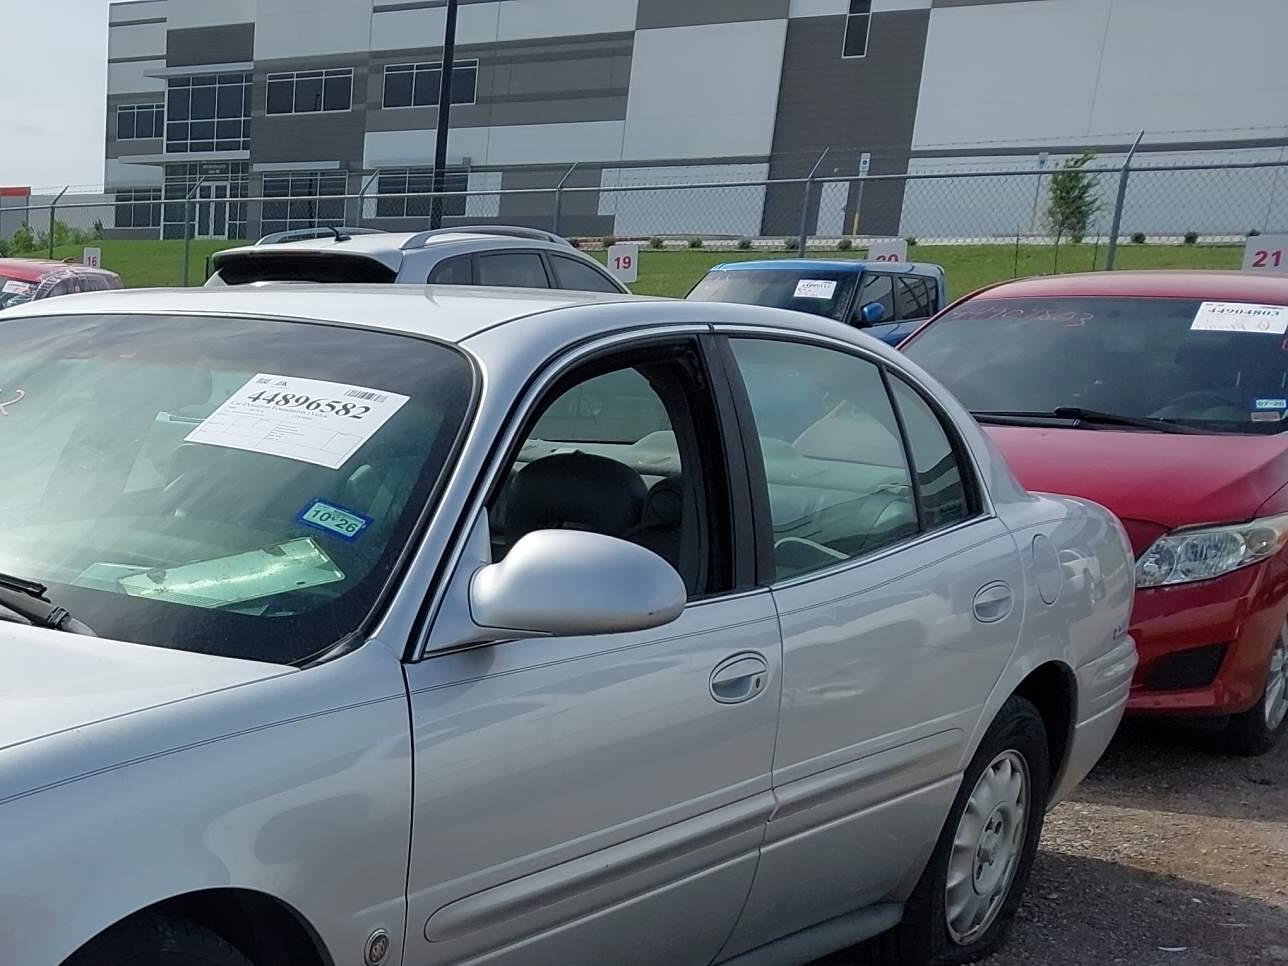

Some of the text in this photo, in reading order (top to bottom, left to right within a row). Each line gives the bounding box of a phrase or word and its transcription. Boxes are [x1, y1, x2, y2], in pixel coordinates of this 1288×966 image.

[88, 256, 97, 267] 16
[615, 256, 632, 270] 19
[1252, 250, 1281, 268] 21
[247, 390, 371, 420] 44896582
